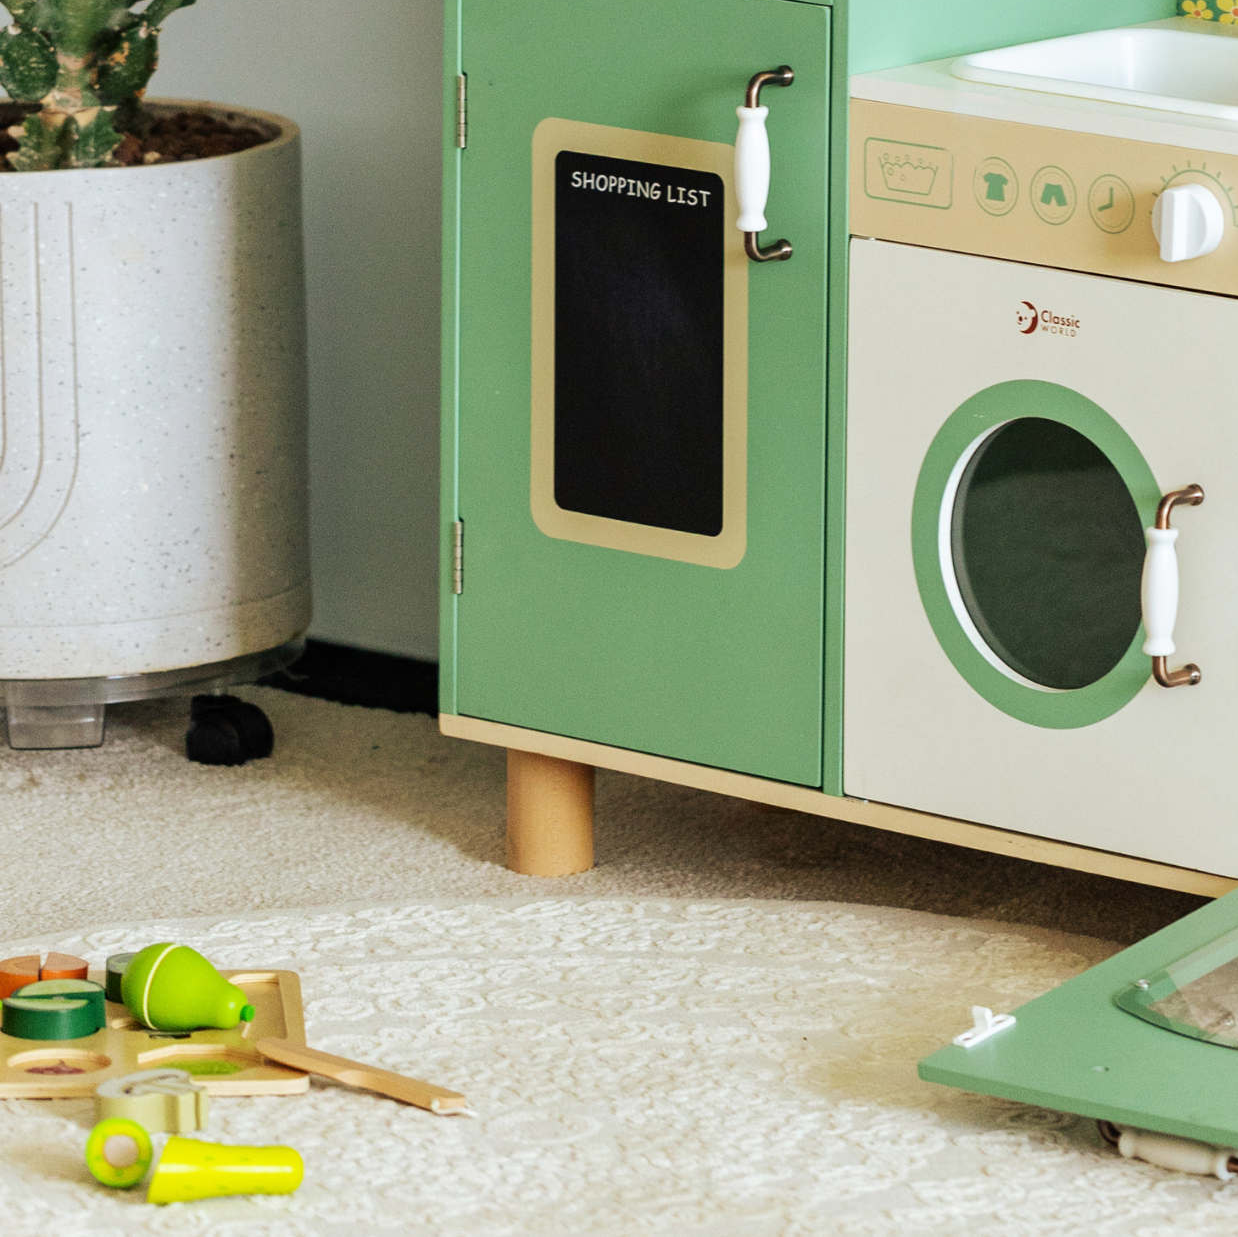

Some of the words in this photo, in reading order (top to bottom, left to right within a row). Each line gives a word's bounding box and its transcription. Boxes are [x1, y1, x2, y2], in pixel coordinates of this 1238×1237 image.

[571, 171, 661, 200] SHOPPING
[667, 185, 711, 207] LIST
[1041, 310, 1081, 328] Classic
[1041, 325, 1076, 337] WORLD
